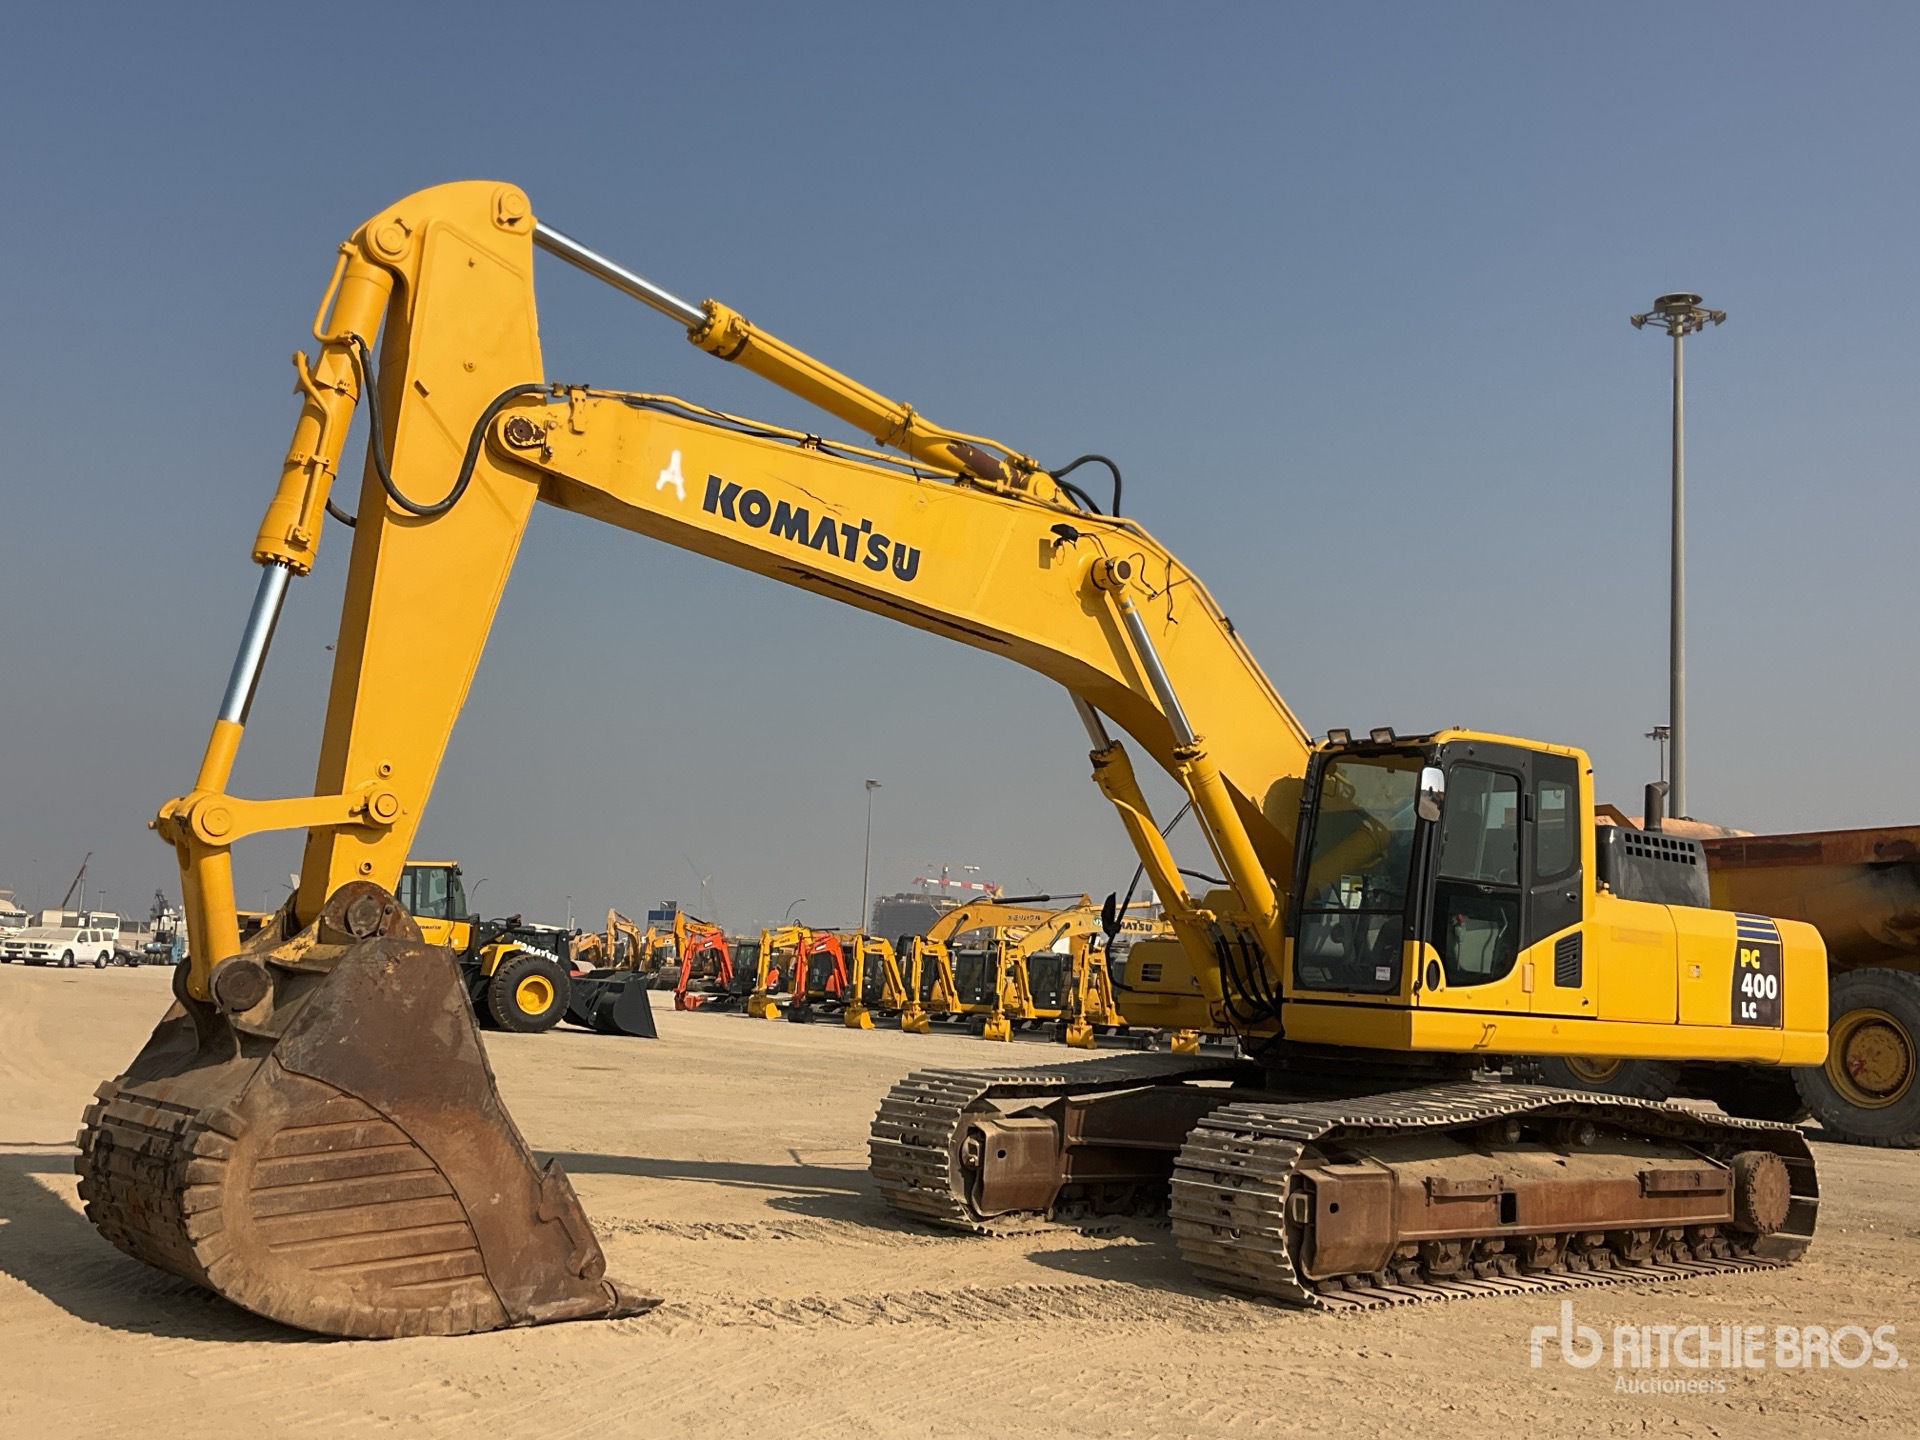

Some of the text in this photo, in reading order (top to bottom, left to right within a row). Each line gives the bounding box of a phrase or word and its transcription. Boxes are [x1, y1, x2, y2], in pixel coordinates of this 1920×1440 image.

[702, 474, 920, 581] KOMATSU
[1740, 948, 1760, 969] PC
[1741, 973, 1777, 999] 400
[1741, 1001, 1757, 1019] LC
